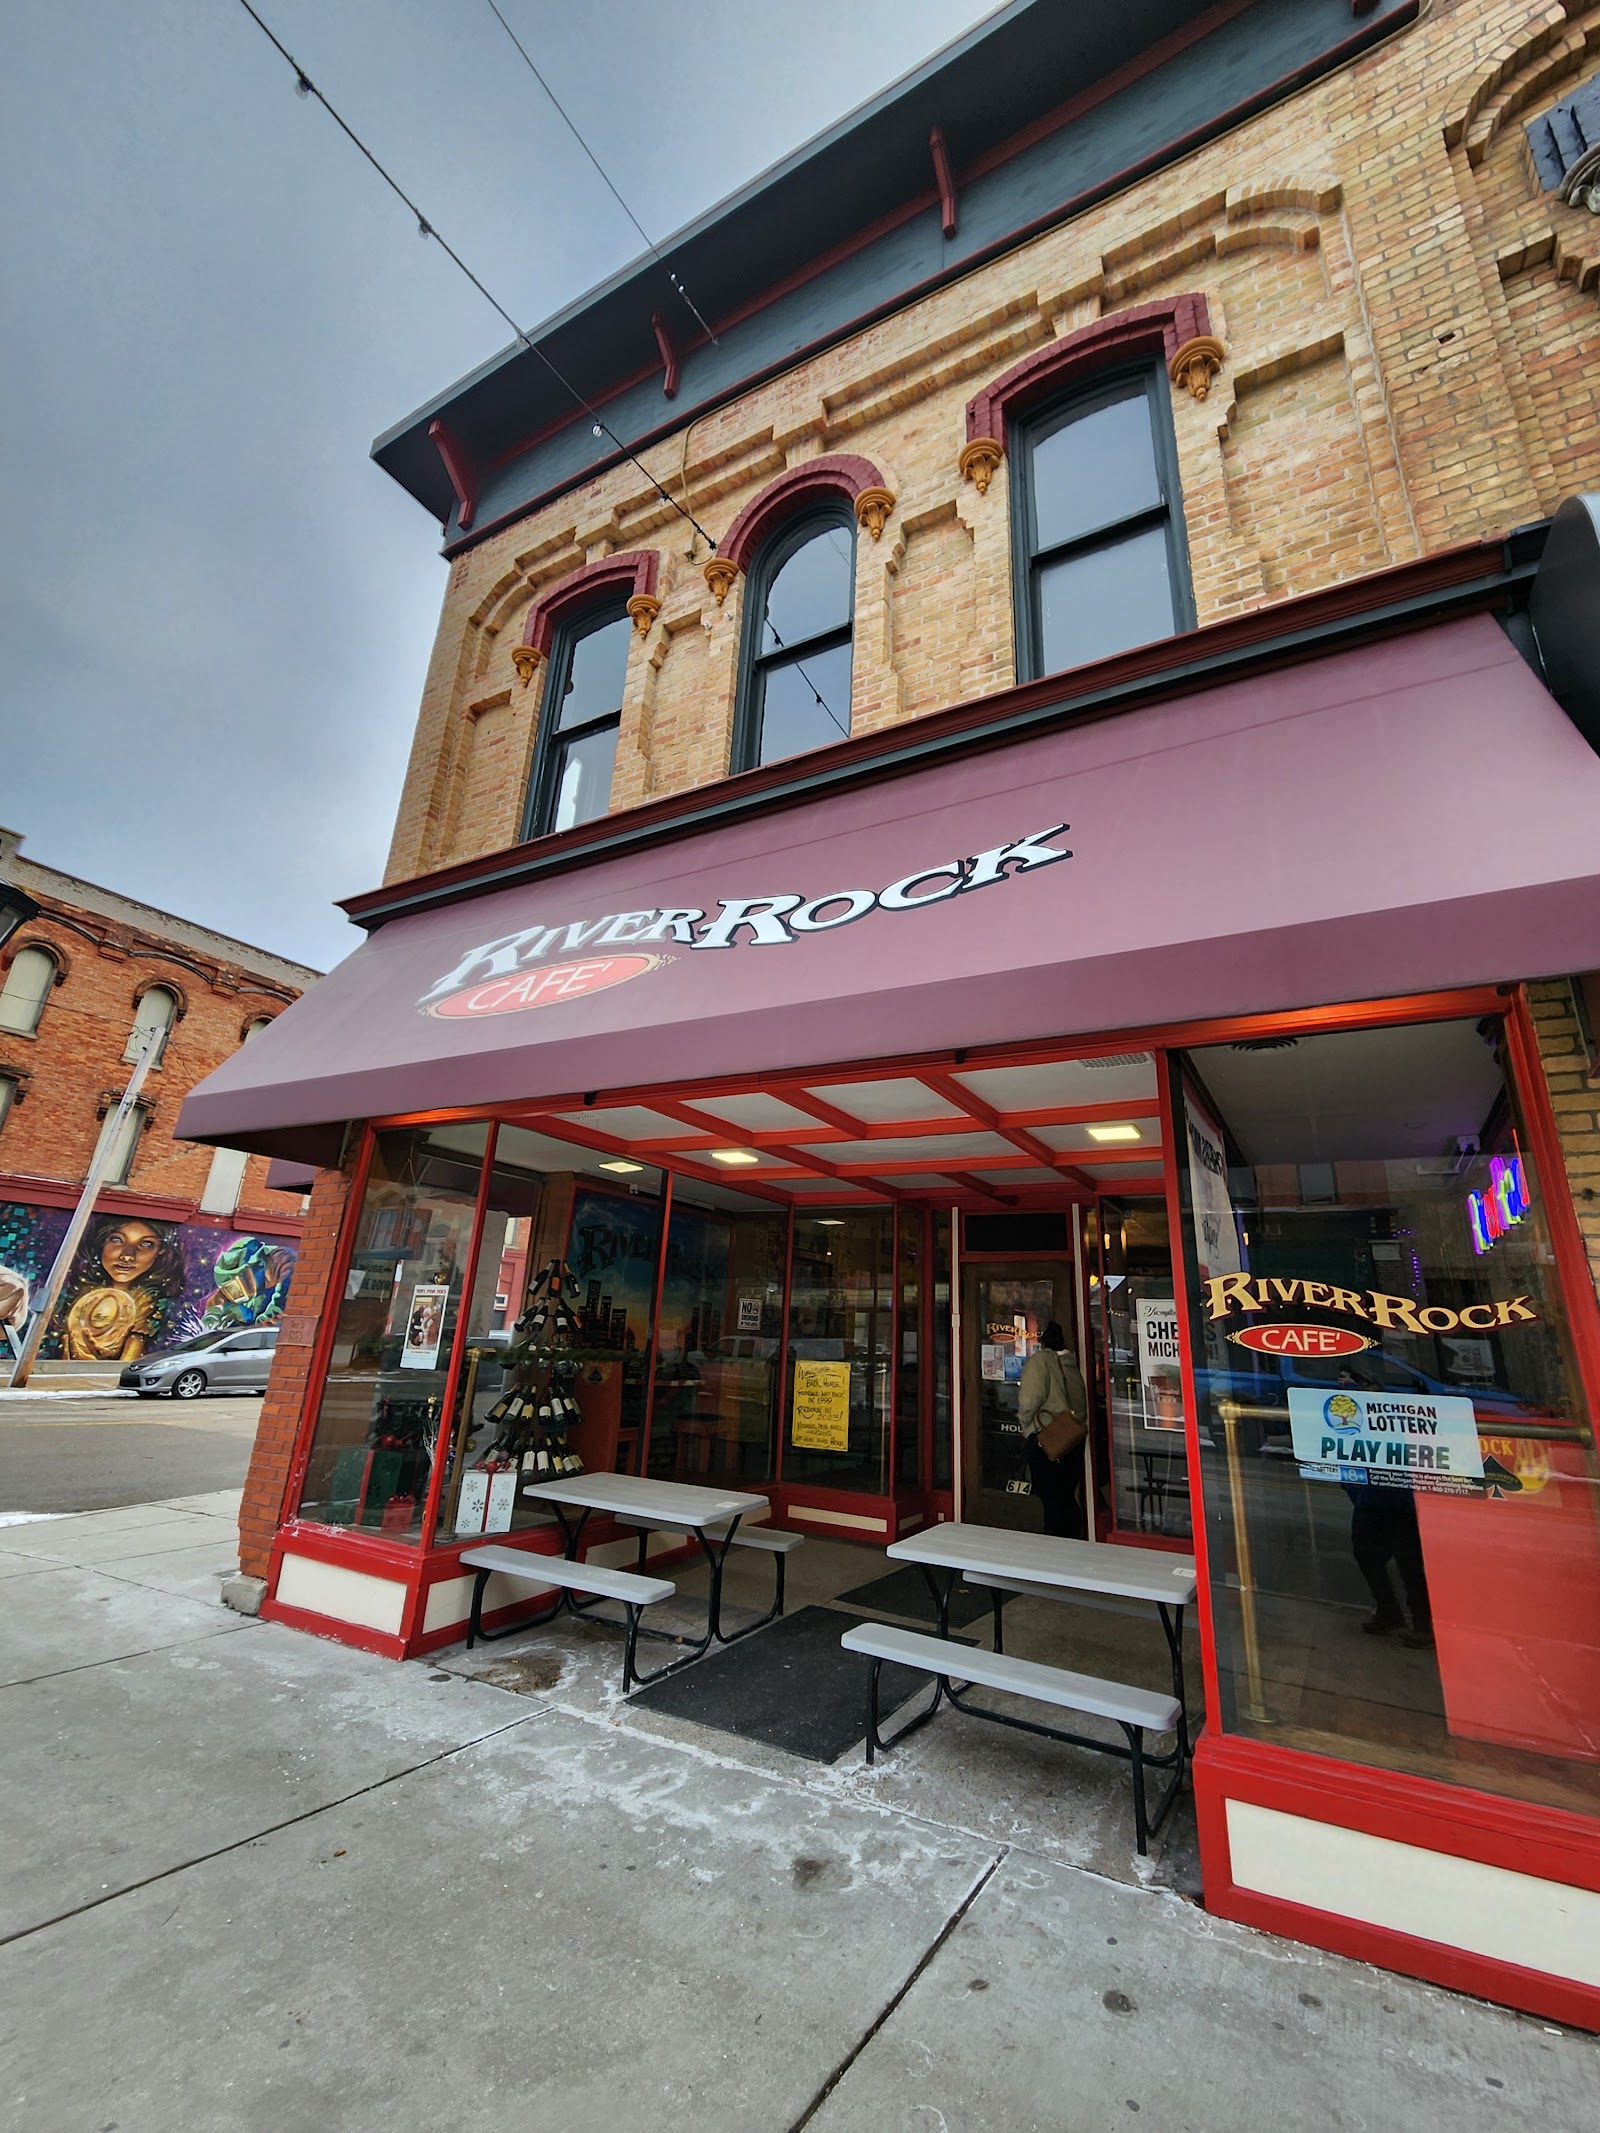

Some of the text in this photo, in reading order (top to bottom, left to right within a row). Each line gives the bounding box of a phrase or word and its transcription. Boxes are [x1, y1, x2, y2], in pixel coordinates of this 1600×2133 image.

[419, 823, 1073, 1002] RIVER ROCK
[577, 1225, 658, 1278] RIVE
[367, 1264, 384, 1273] USE
[742, 1302, 753, 1313] NO
[1203, 1271, 1537, 1335] RIVER ROCK
[1144, 1306, 1177, 1317] Yuengli
[986, 1322, 1018, 1335] RIVER
[1366, 1402, 1437, 1419] MICHIGAN
[1001, 1424, 1022, 1433] HOU
[1368, 1415, 1438, 1435] LOTTERY
[1321, 1437, 1450, 1470] PLAY HERE
[1478, 1438, 1514, 1456] OCK
[1343, 1469, 1365, 1482] 18+
[1007, 1481, 1031, 1493] 614
